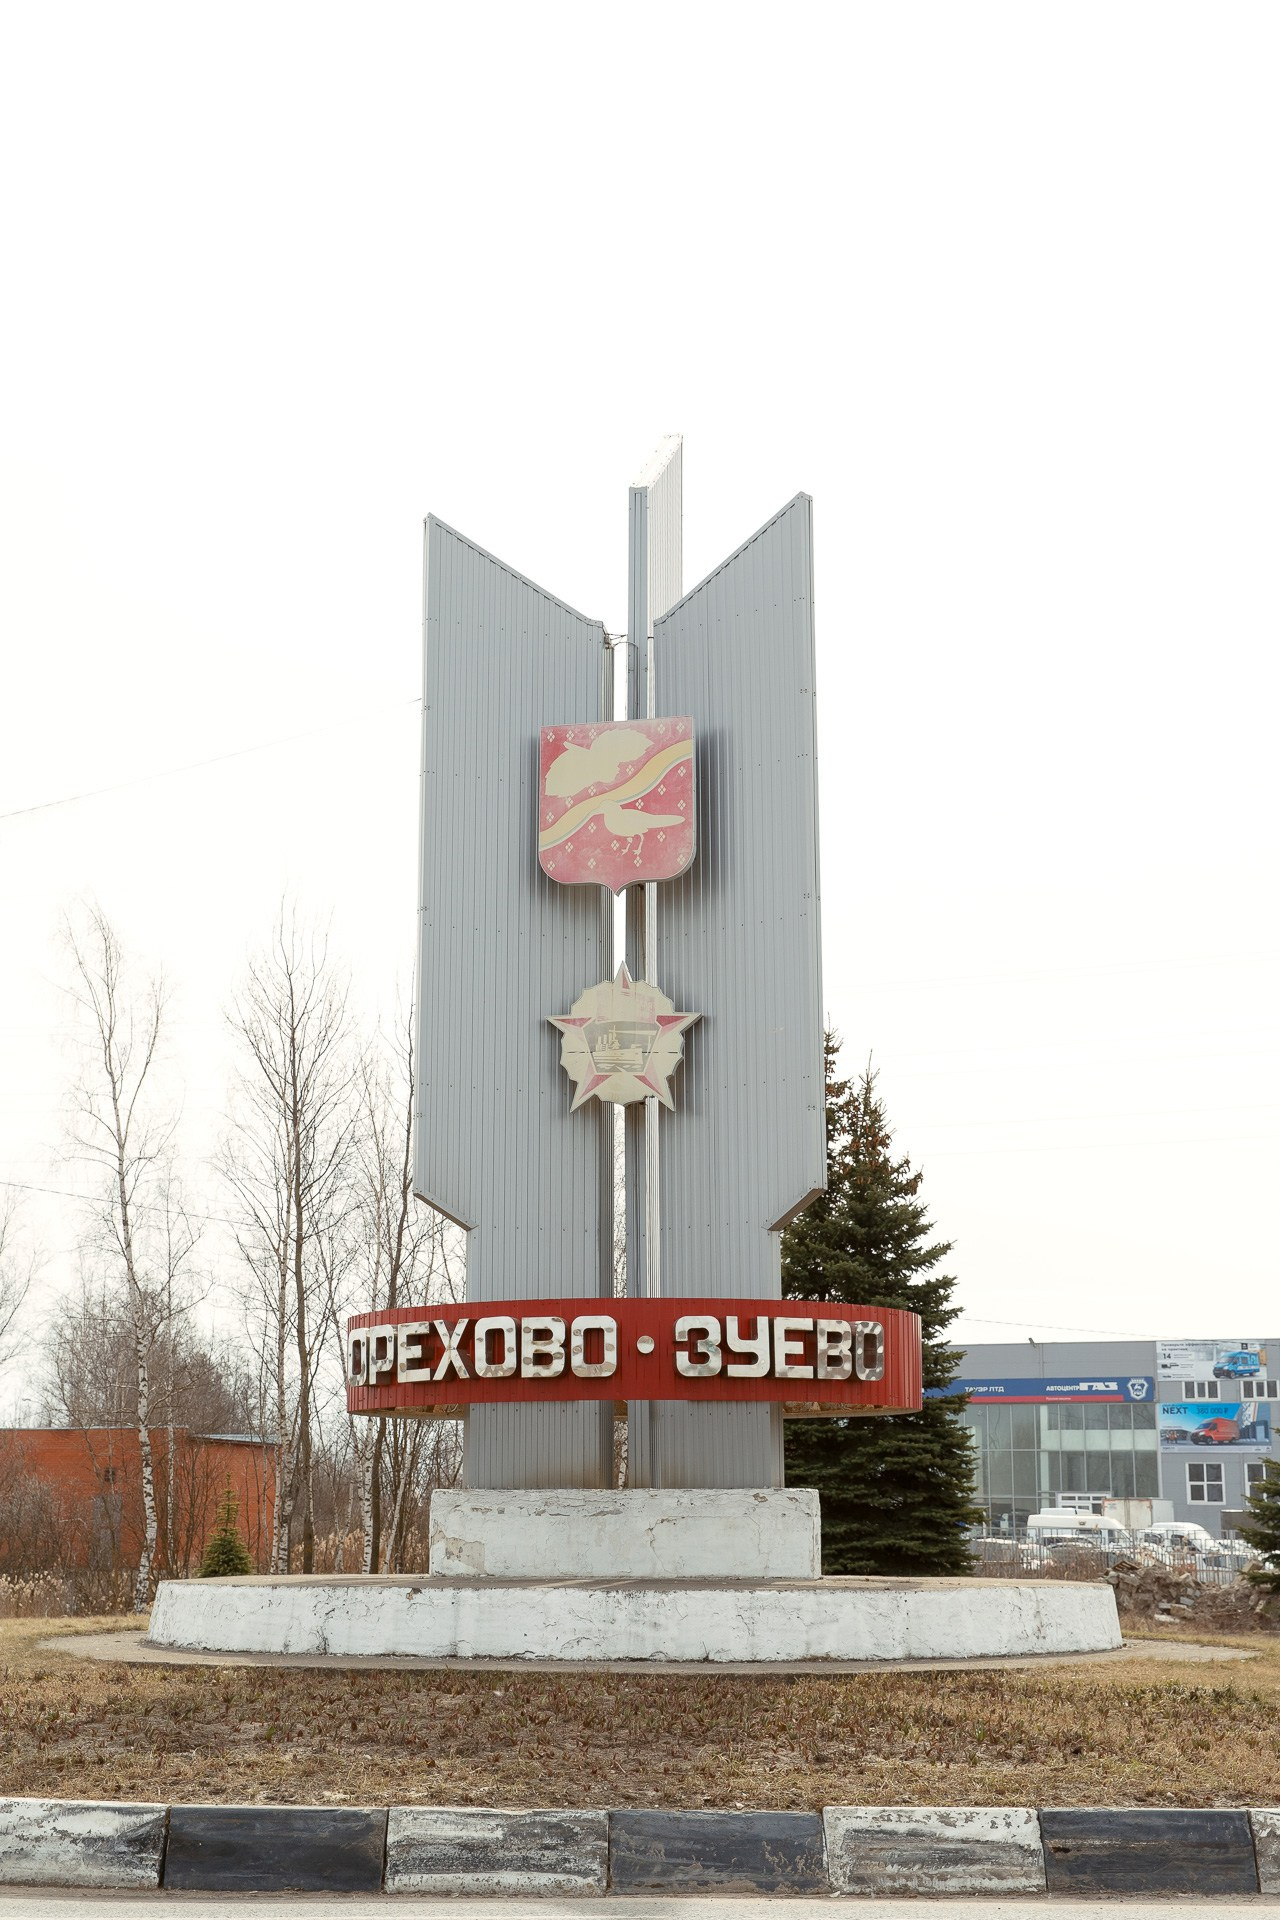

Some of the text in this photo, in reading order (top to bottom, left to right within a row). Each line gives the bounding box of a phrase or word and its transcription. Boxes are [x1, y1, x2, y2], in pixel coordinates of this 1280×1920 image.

[349, 1315, 885, 1386] ОРЕХОВО ЗУЕВО
[1079, 1382, 1118, 1390] ГАЗ
[1162, 1407, 1188, 1415] NEXT
